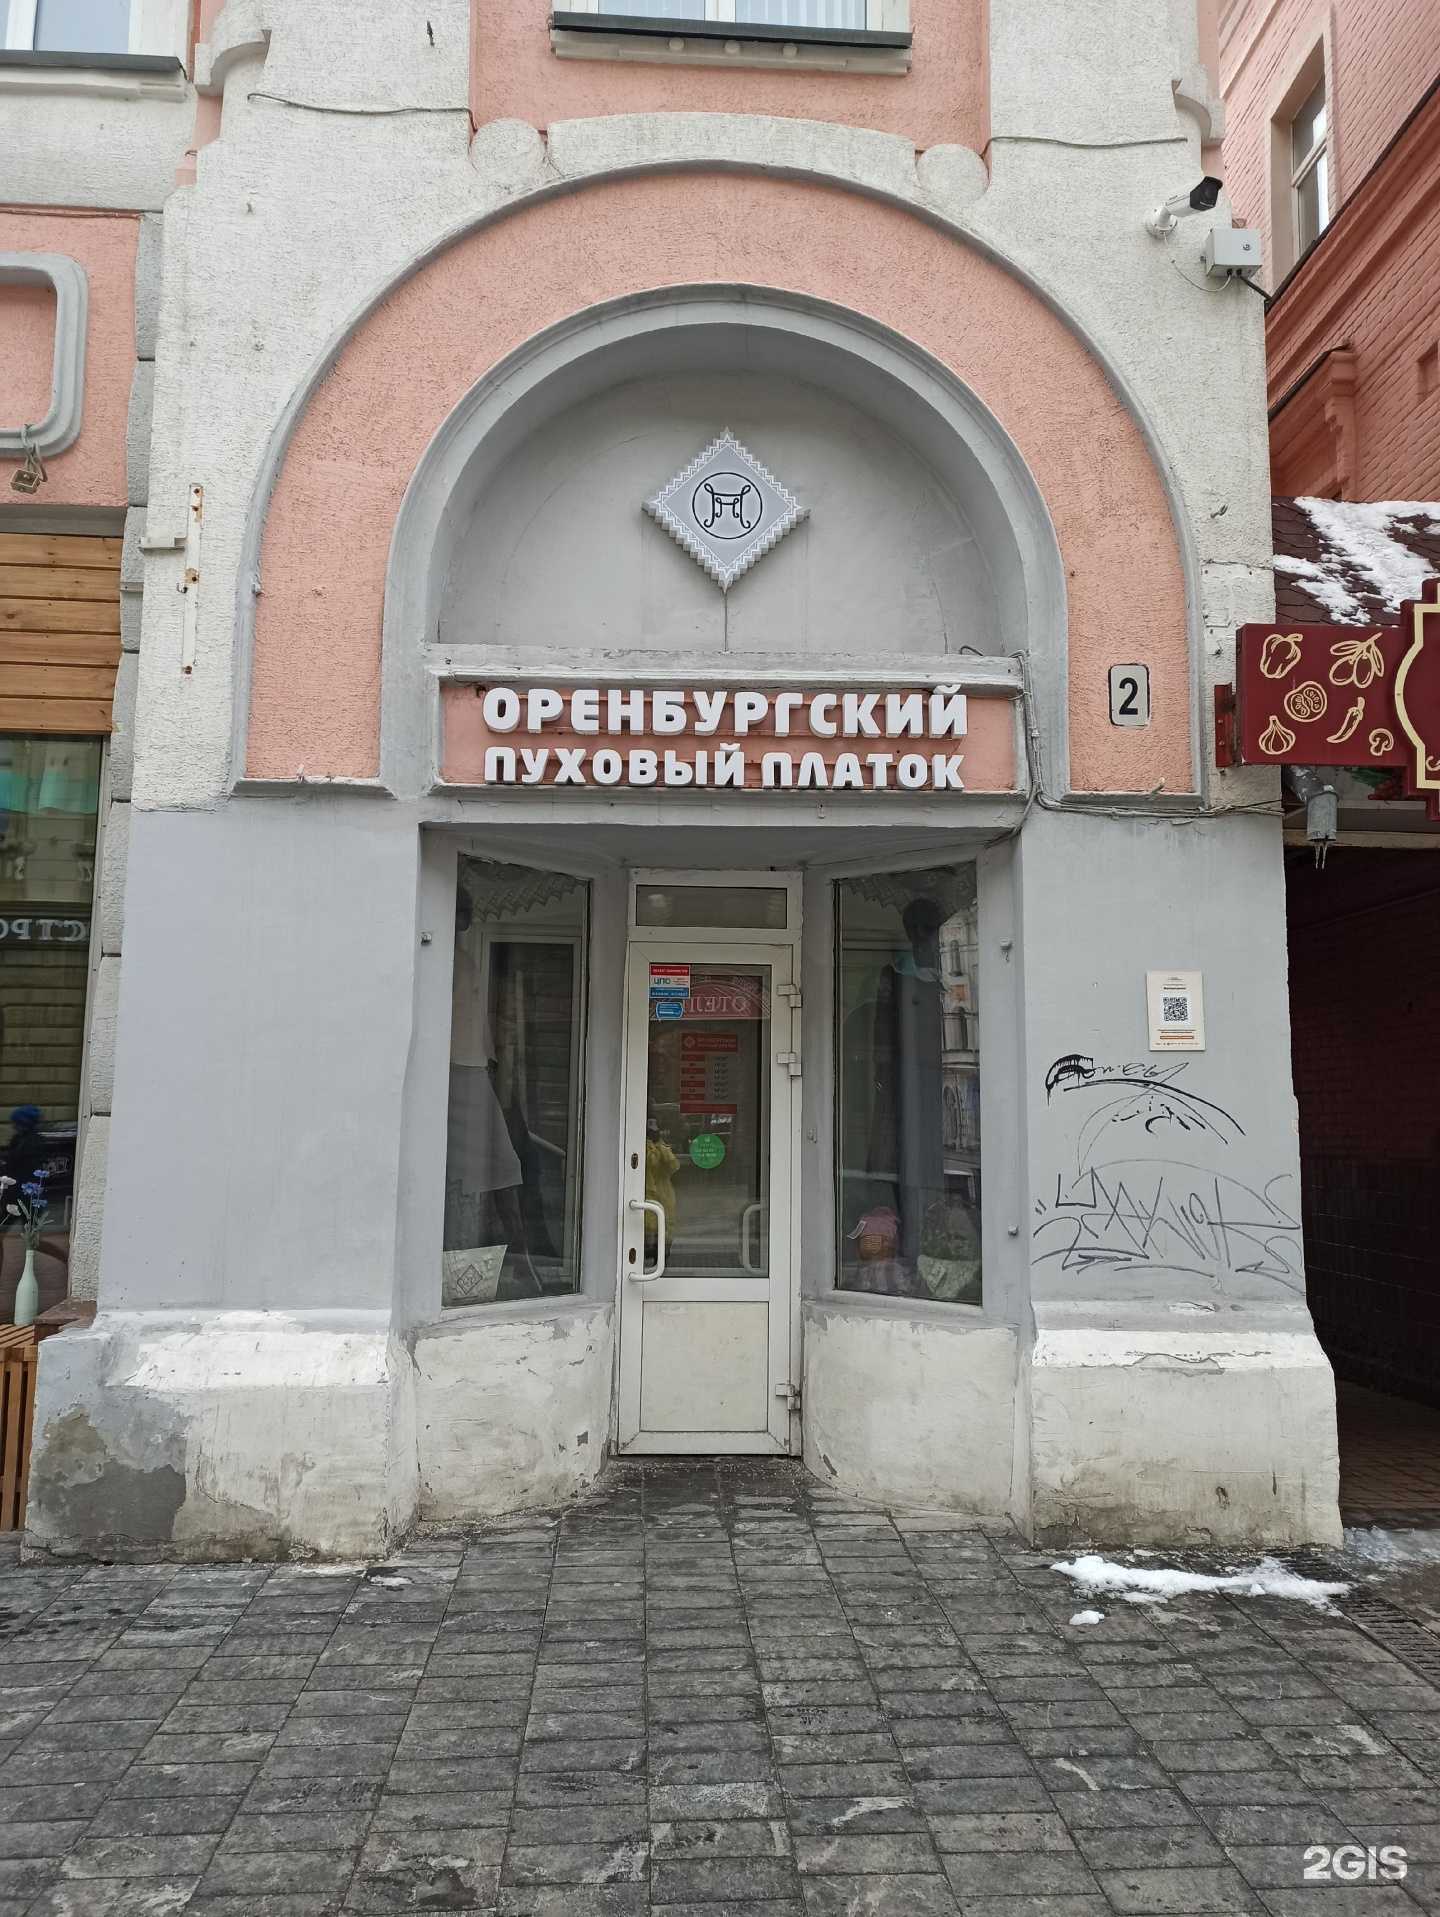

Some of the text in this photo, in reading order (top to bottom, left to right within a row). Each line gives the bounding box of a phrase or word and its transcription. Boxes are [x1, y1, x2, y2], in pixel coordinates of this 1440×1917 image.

[482, 684, 968, 738] ОРЕНБУРГСКИЙ
[1118, 677, 1139, 716] 2
[484, 743, 965, 790] ПУХОВЫЙ ПЛАТОК
